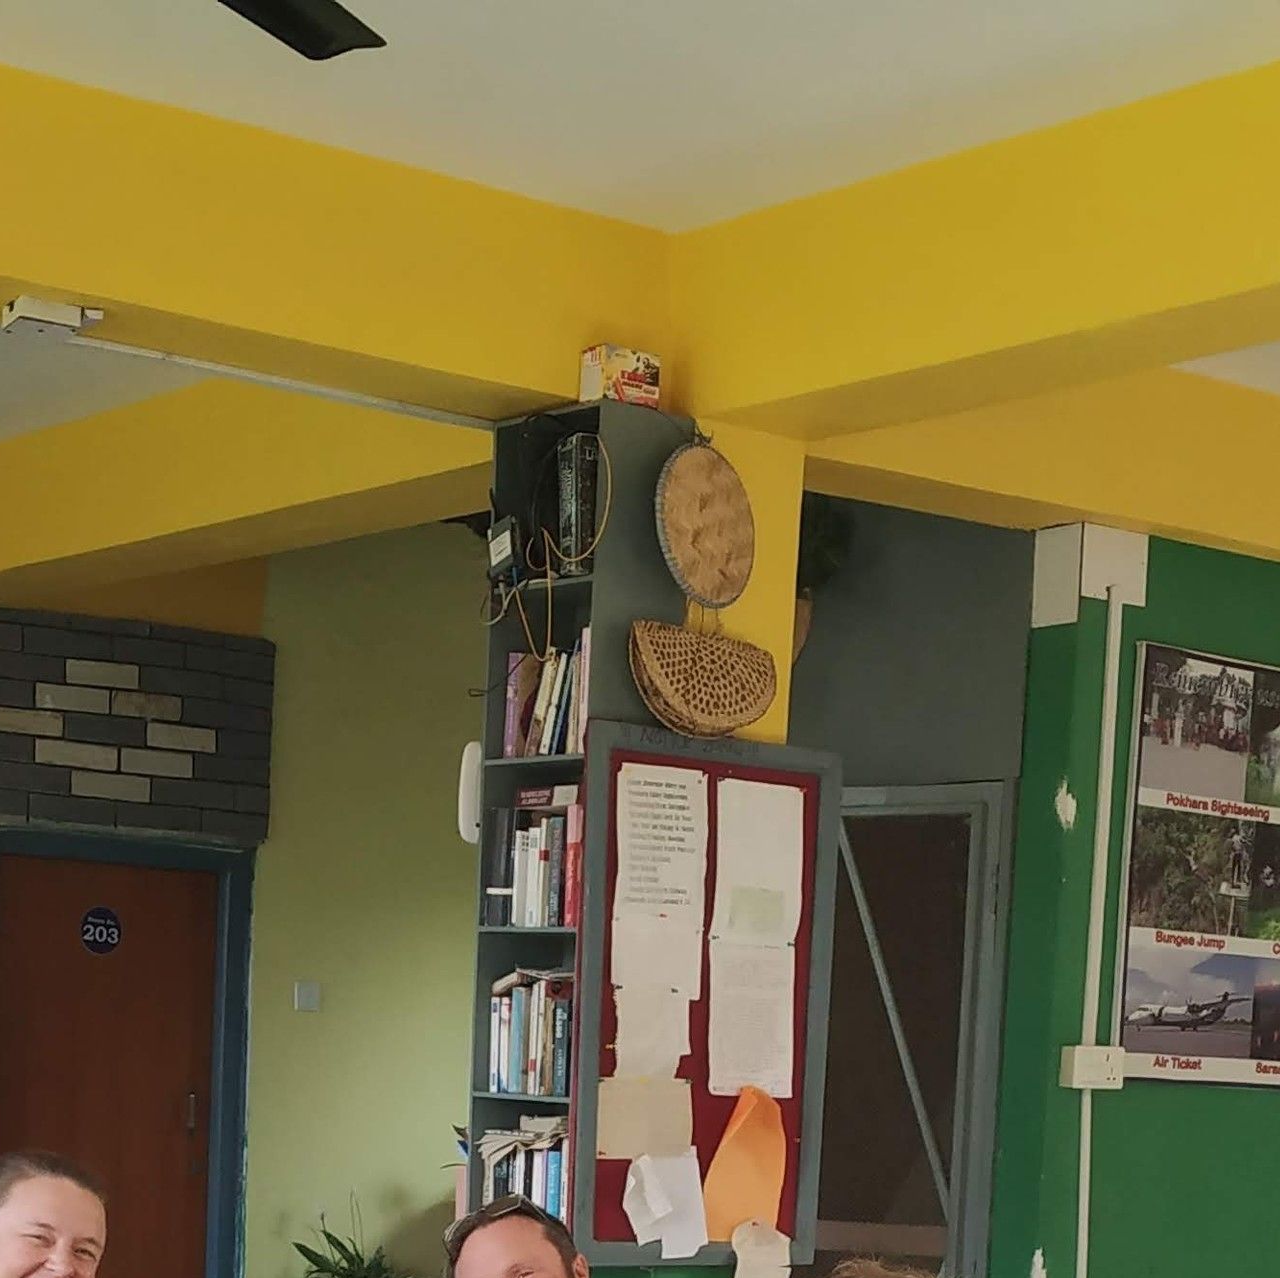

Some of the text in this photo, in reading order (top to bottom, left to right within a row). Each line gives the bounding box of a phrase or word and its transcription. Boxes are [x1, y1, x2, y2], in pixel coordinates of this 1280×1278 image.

[1166, 793, 1270, 821] Pokhara Sightseeing
[82, 923, 119, 944] 203
[1156, 930, 1226, 951] Bungee Jump
[1153, 1055, 1202, 1071] Air Ticket
